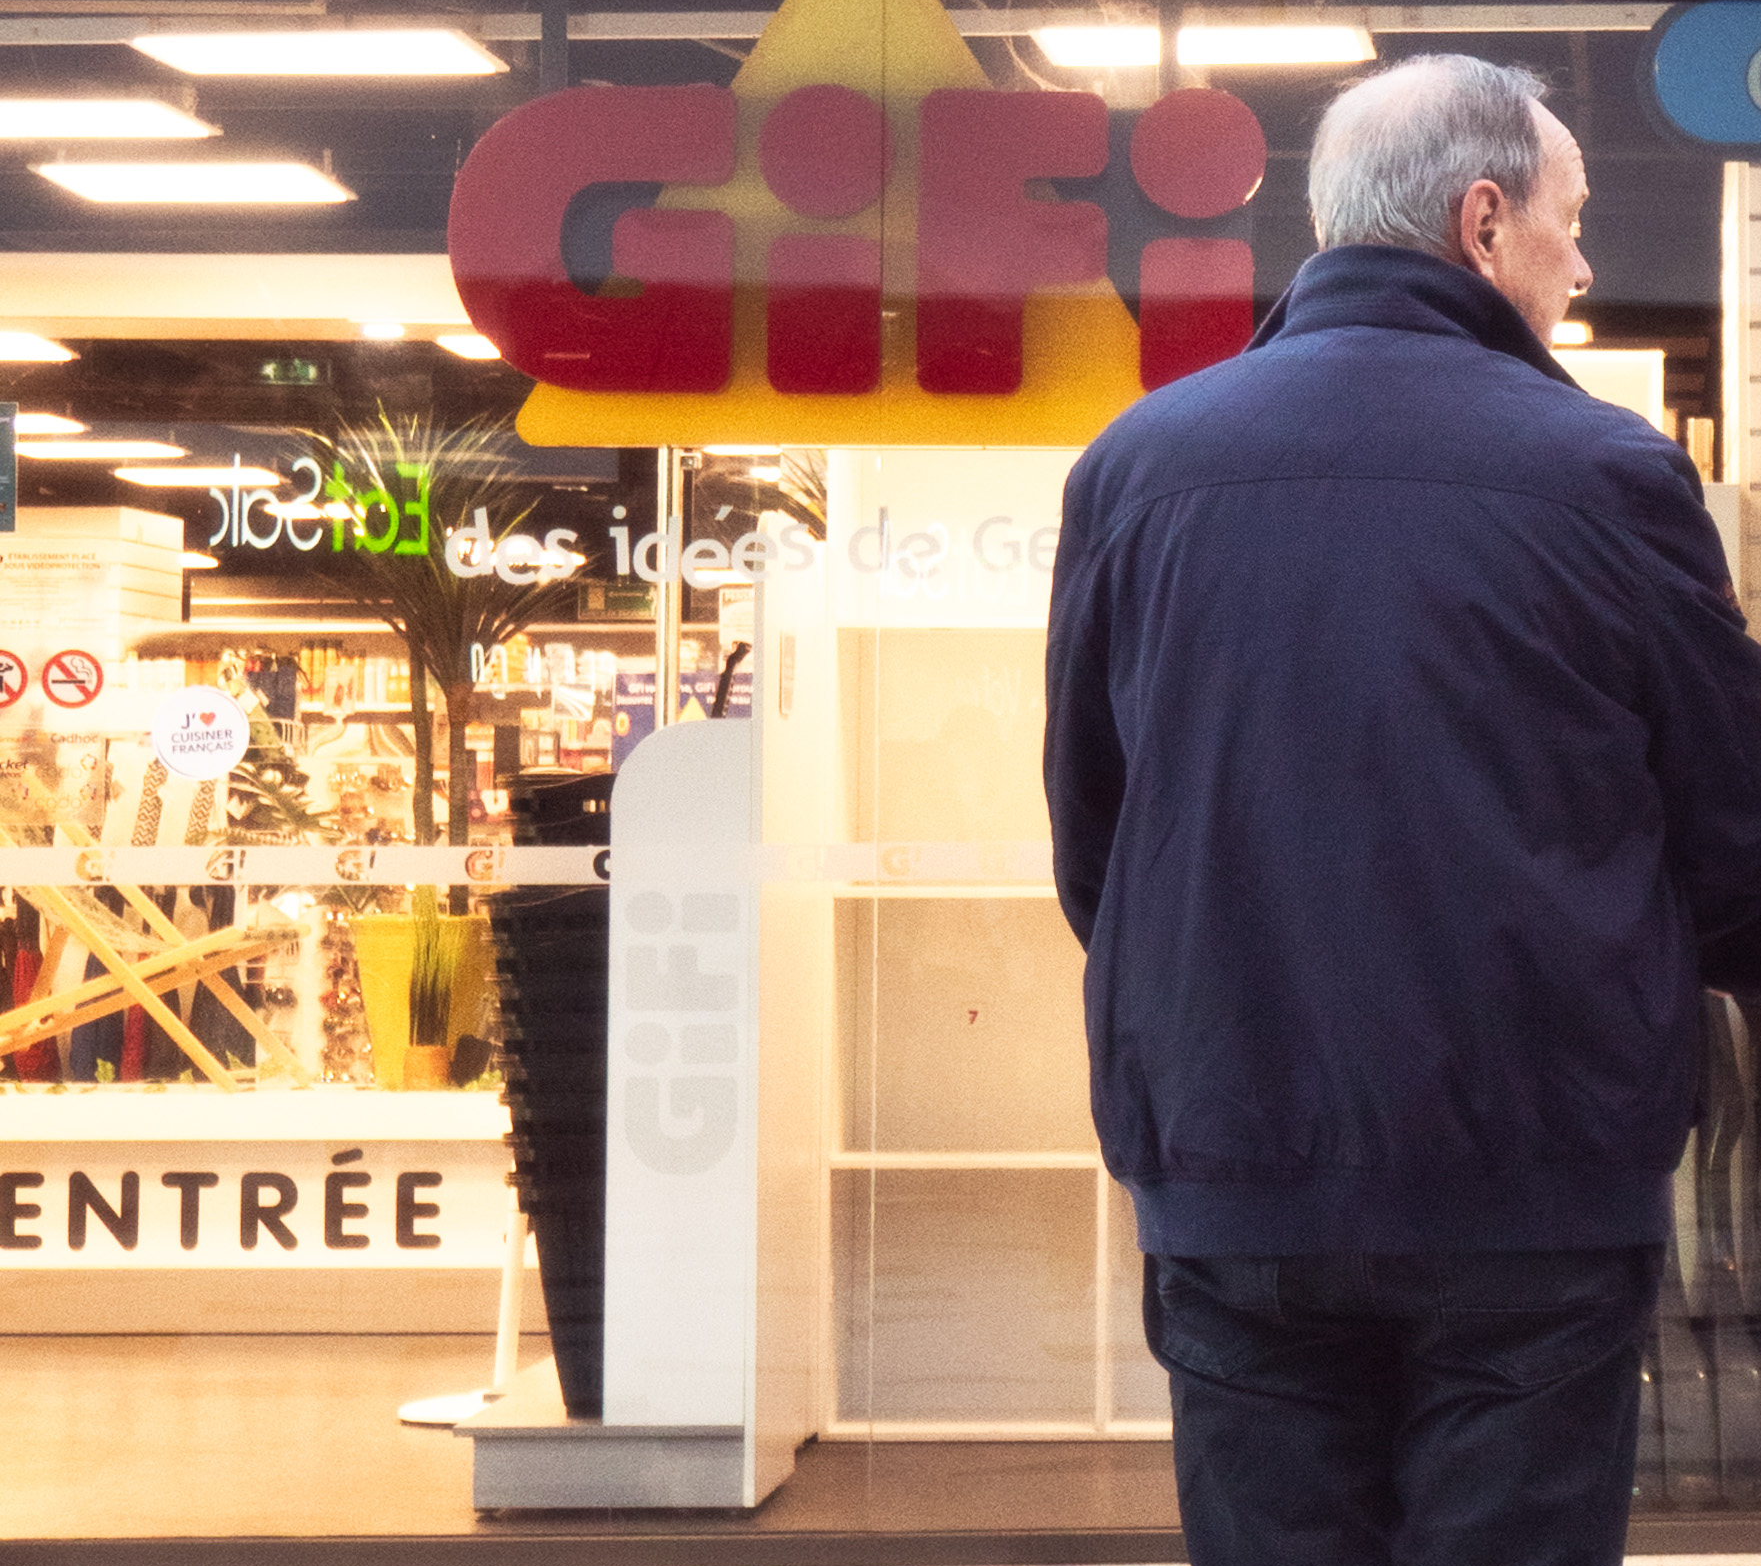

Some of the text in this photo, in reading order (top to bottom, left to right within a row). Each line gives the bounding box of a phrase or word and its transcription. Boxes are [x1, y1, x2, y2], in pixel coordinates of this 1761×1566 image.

[447, 83, 1267, 395] GiFi
[445, 506, 579, 585] des
[609, 505, 815, 590] idées
[848, 506, 942, 580] de
[181, 713, 196, 730] J'
[50, 732, 99, 744] Cadhoc
[171, 728, 234, 744] CUISINER
[171, 741, 235, 755] FRANÇAIS
[0, 759, 28, 771] cket
[624, 891, 741, 1175] GiFi
[0, 1148, 443, 1251] ENTRÉE
